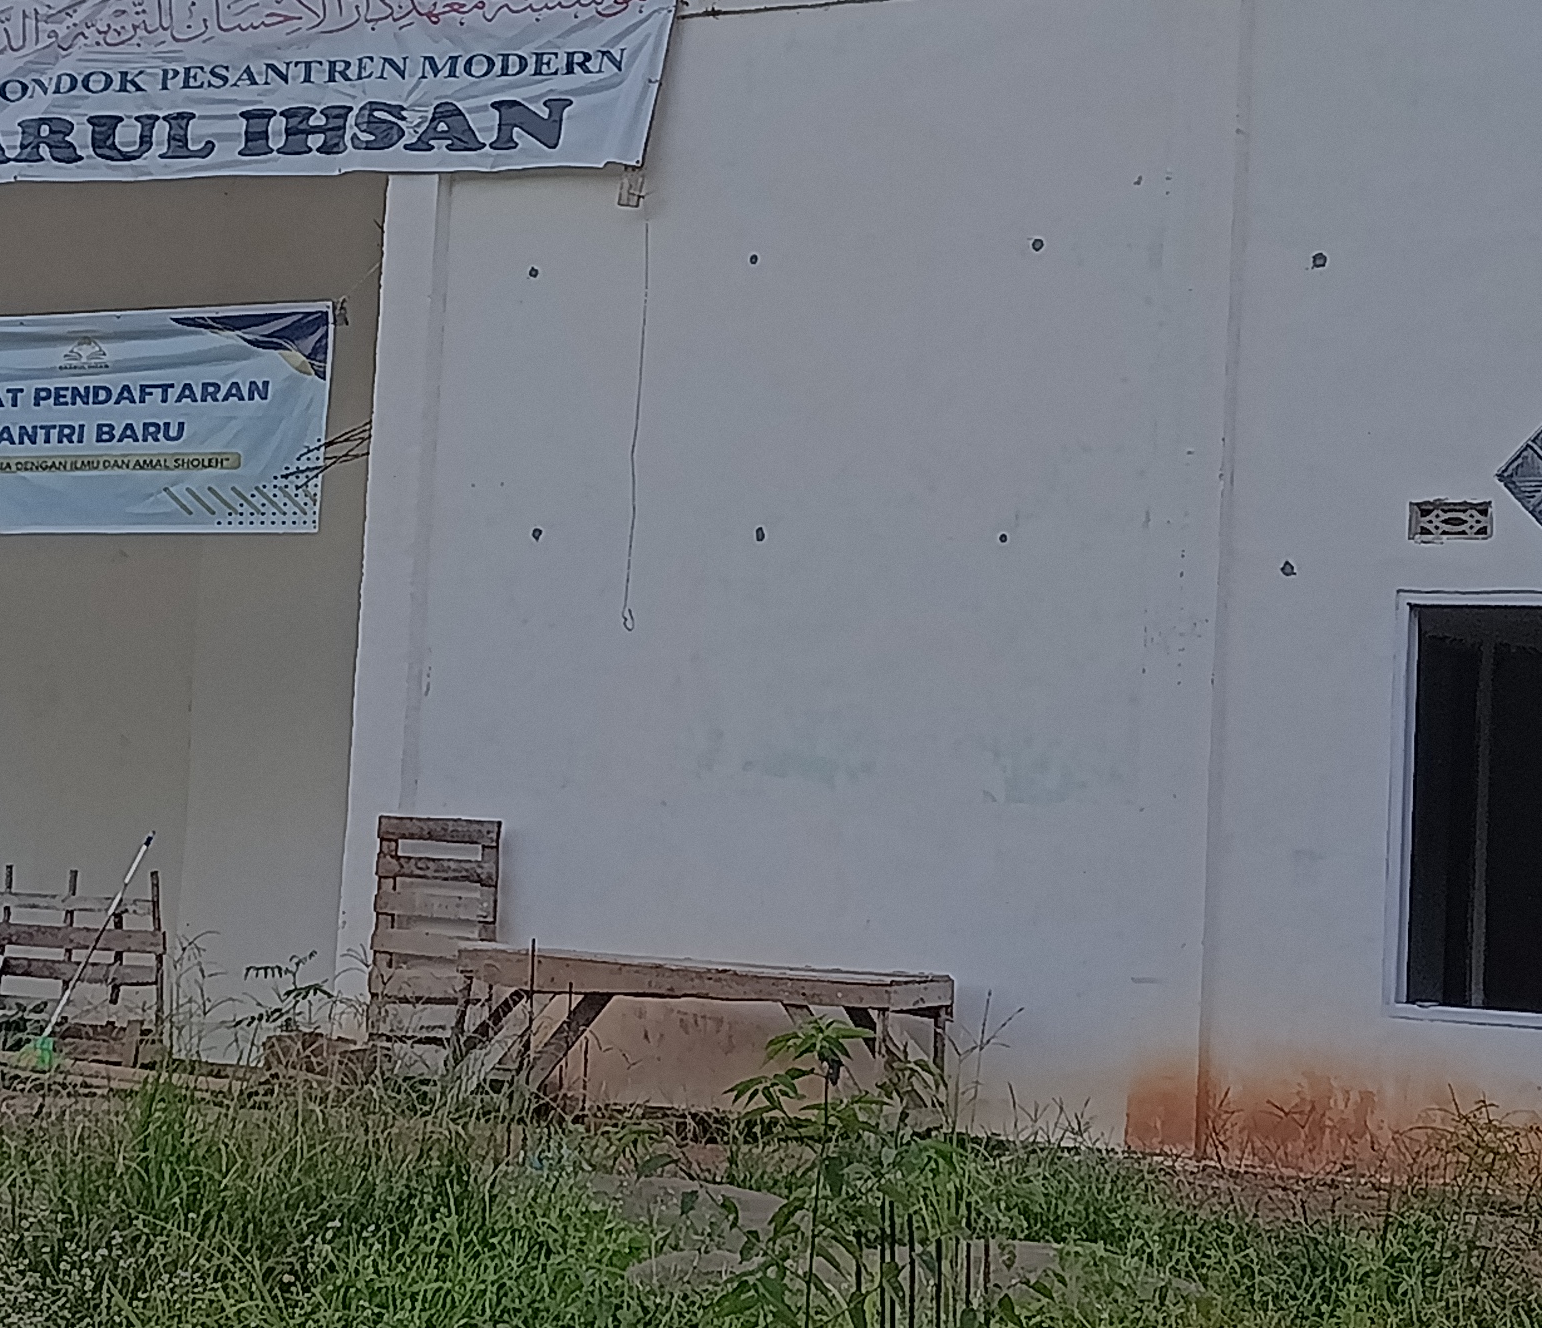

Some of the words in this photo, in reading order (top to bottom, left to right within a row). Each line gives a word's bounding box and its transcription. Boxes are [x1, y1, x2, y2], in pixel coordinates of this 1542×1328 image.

[160, 55, 409, 91] PESANTREN
[418, 47, 628, 79] MODERN
[238, 98, 574, 157] IHSAN
[33, 380, 271, 408] PENDAFTARAN
[95, 421, 186, 444] BARU
[15, 460, 68, 472] DENGAN
[70, 459, 100, 471] ILMU
[102, 459, 130, 470] DAN
[132, 459, 169, 470] AMAL
